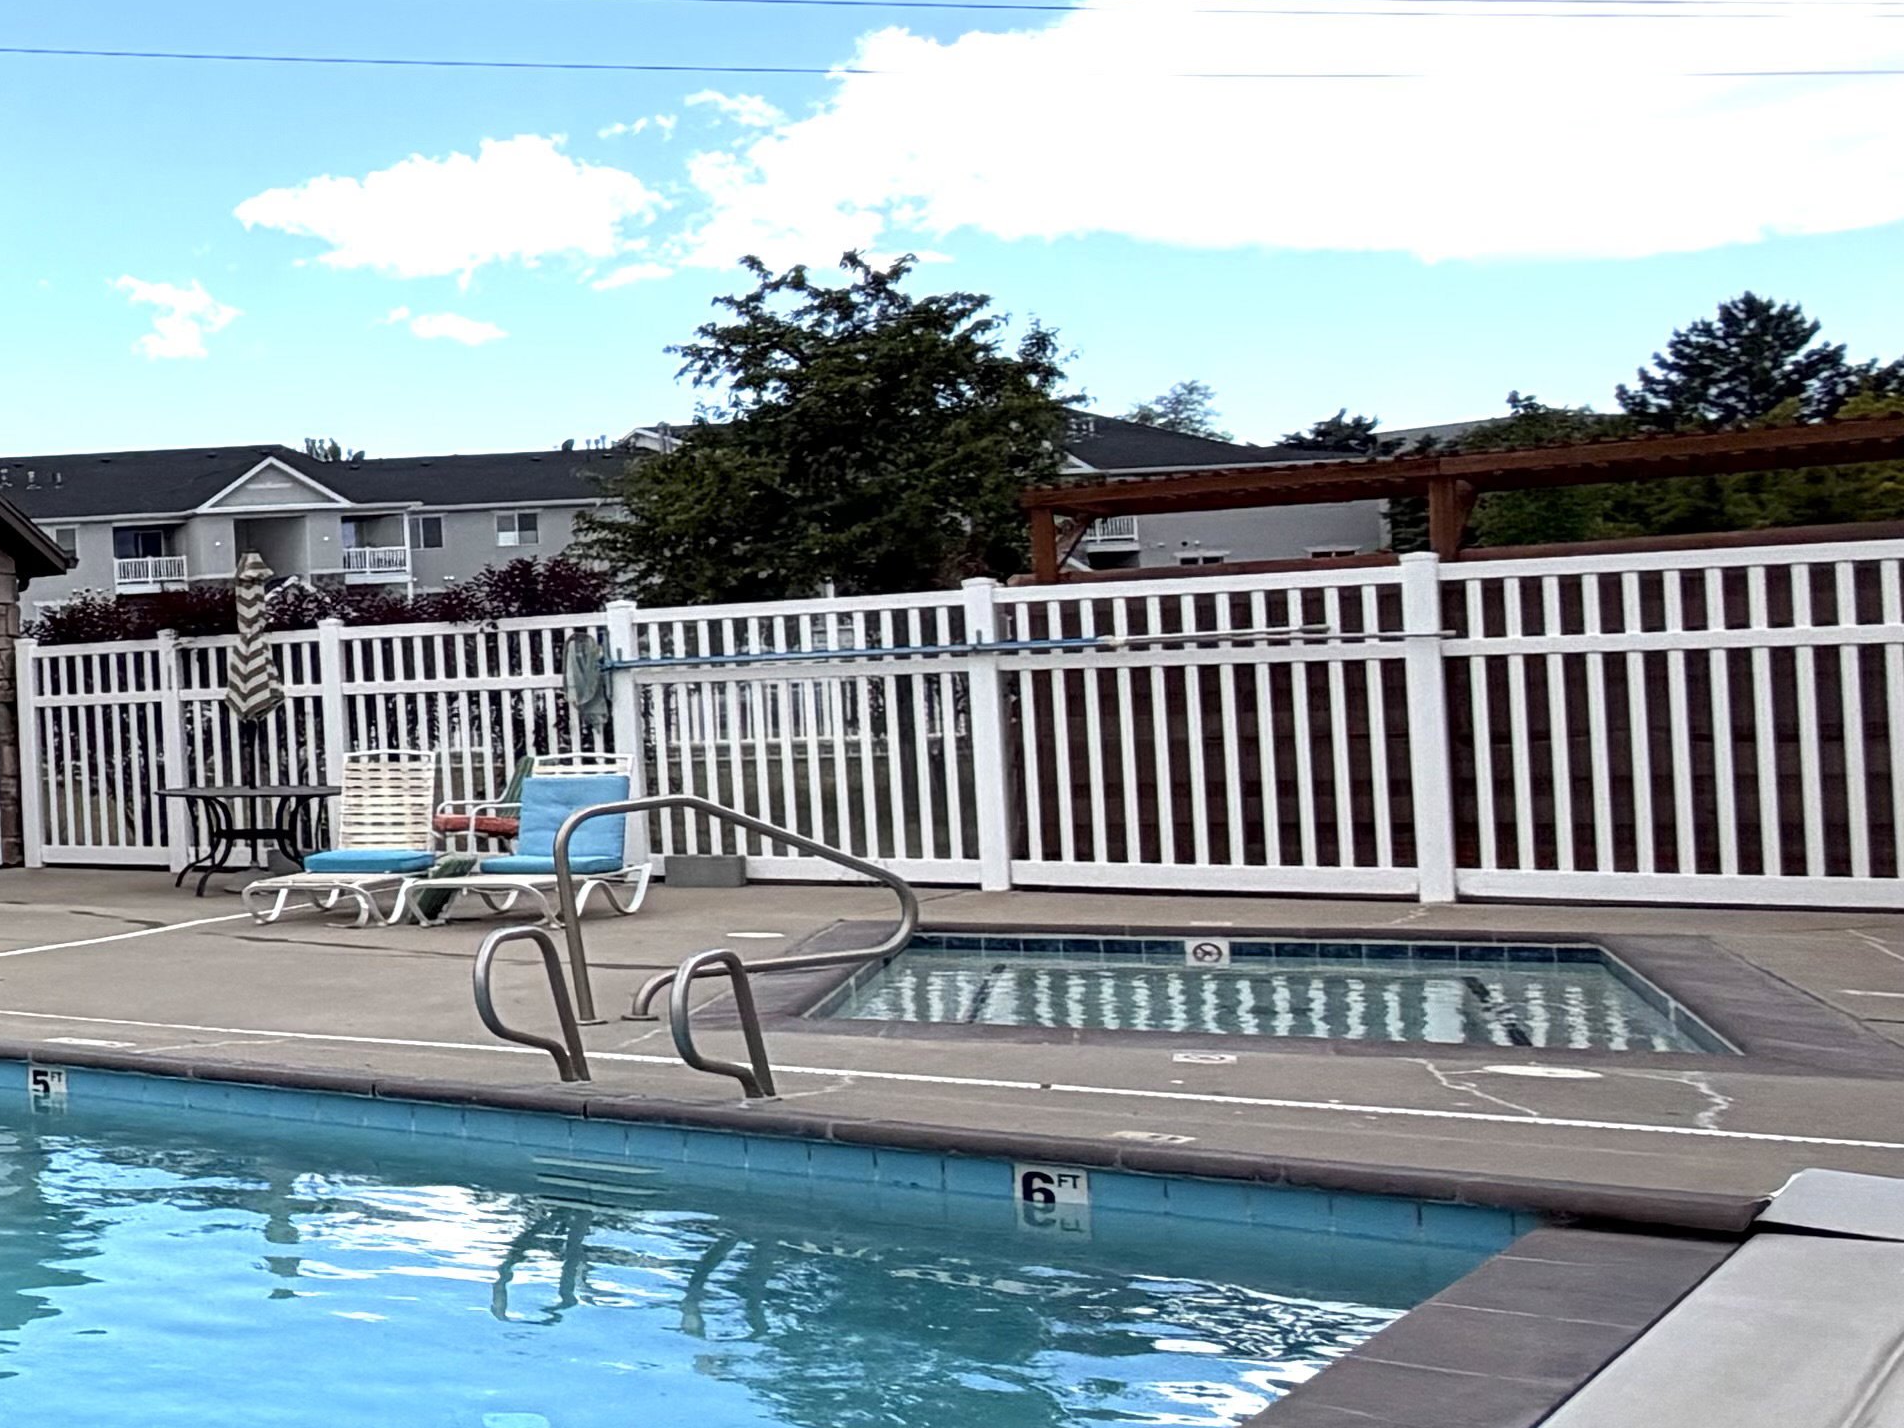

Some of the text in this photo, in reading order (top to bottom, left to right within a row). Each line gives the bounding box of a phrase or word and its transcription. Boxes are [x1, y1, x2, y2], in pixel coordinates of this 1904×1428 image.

[32, 1070, 62, 1093] 5 FT
[1022, 1171, 1080, 1204] 6 FT
